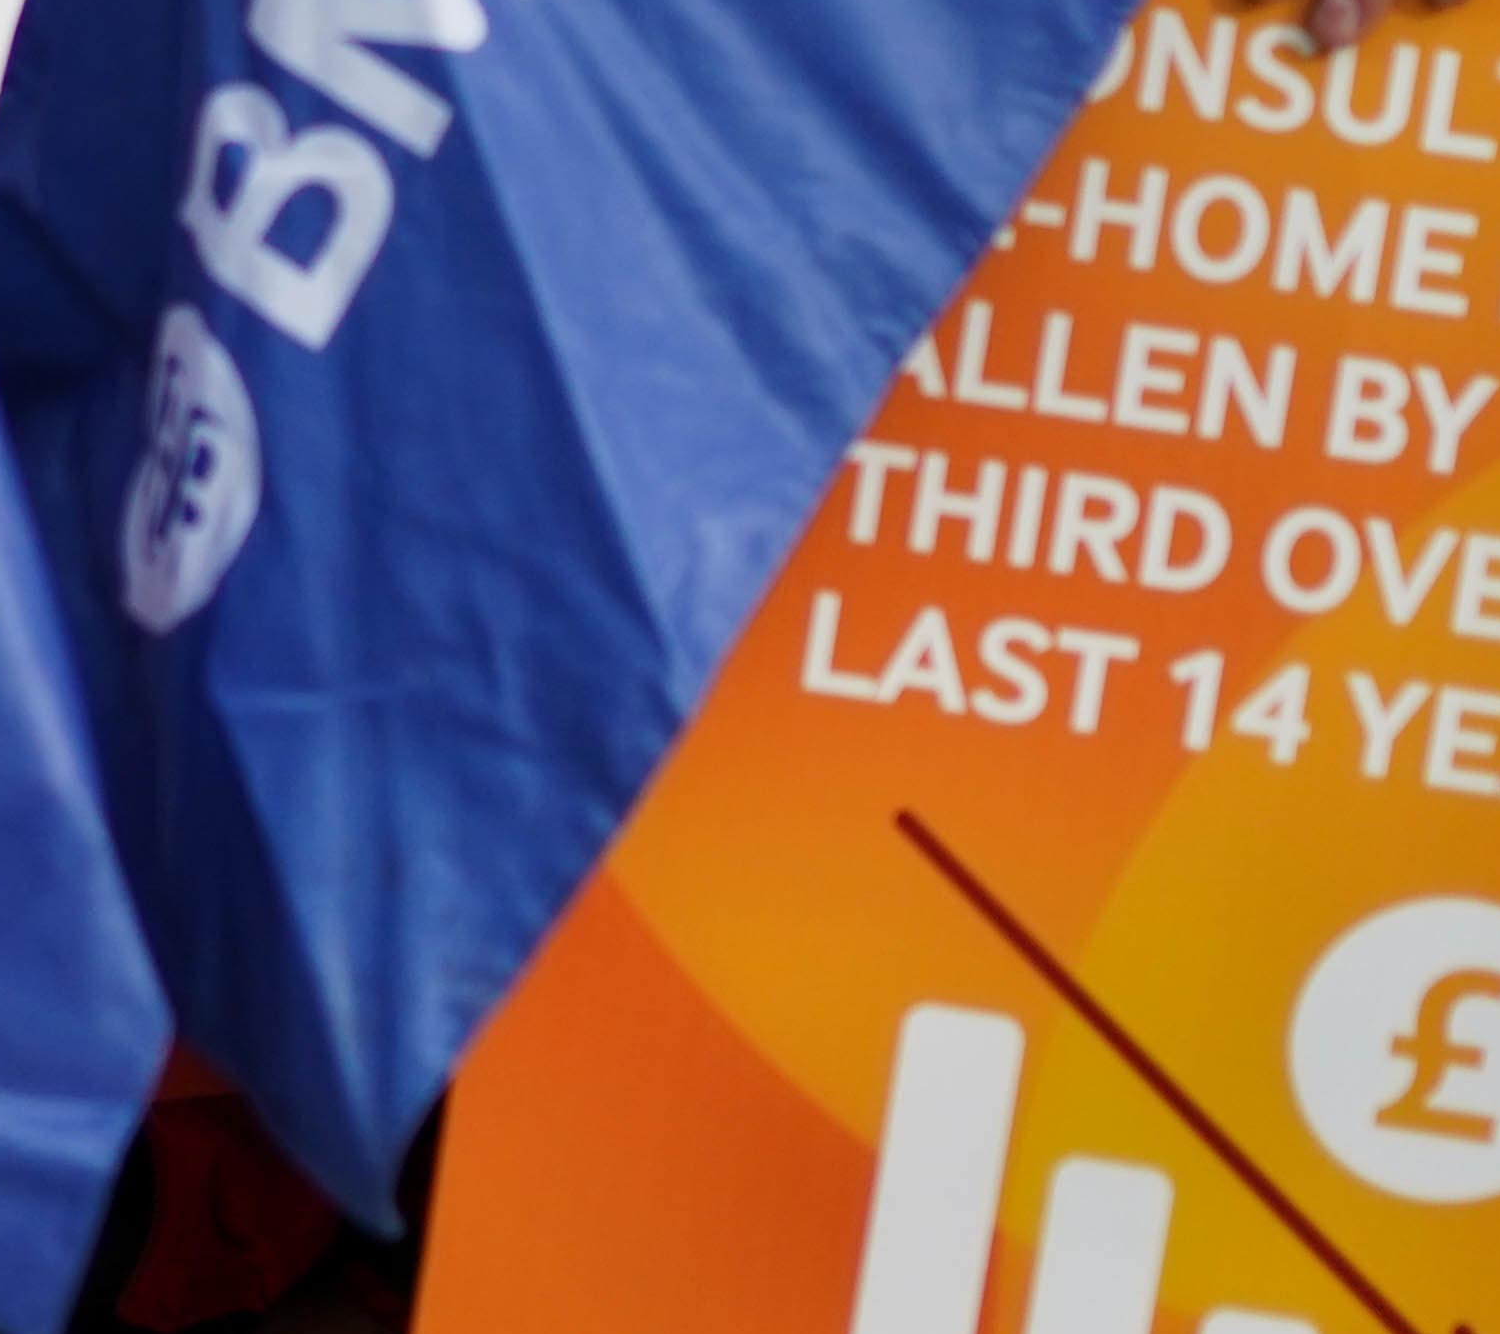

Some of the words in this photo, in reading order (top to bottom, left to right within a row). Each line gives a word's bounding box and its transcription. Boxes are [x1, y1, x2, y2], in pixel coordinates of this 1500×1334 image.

[1324, 354, 1499, 475] BY
[846, 437, 1233, 593] THIRD
[800, 590, 1141, 735] LAST
[1169, 649, 1311, 765] 14
